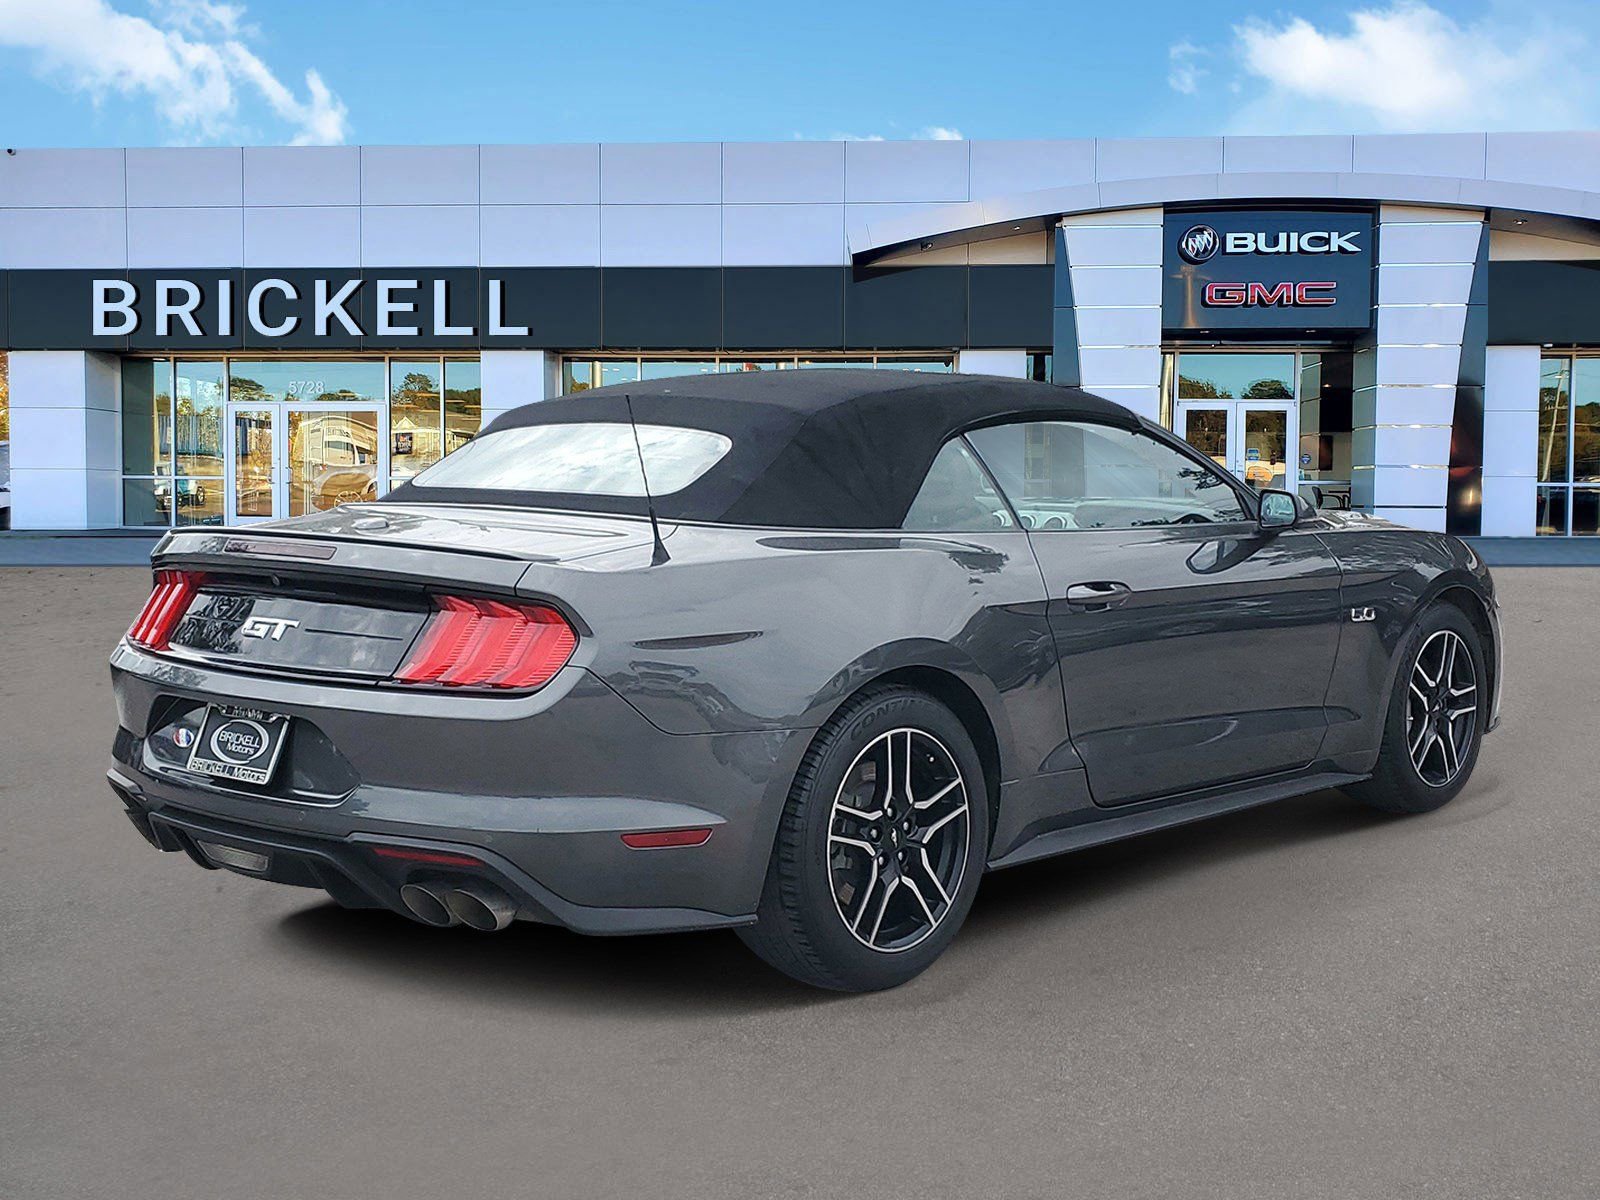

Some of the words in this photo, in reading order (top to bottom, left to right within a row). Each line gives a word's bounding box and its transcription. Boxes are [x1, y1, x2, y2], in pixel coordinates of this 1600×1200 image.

[1225, 231, 1362, 253] BUICK
[1206, 281, 1337, 305] GMC
[92, 278, 530, 337] BRICKELL
[288, 380, 325, 394] 5728
[240, 616, 301, 641] GT
[218, 730, 260, 749] BRICKELL
[226, 742, 255, 755] Motors
[191, 759, 231, 776] BRICKELL
[232, 767, 266, 783] Motors
